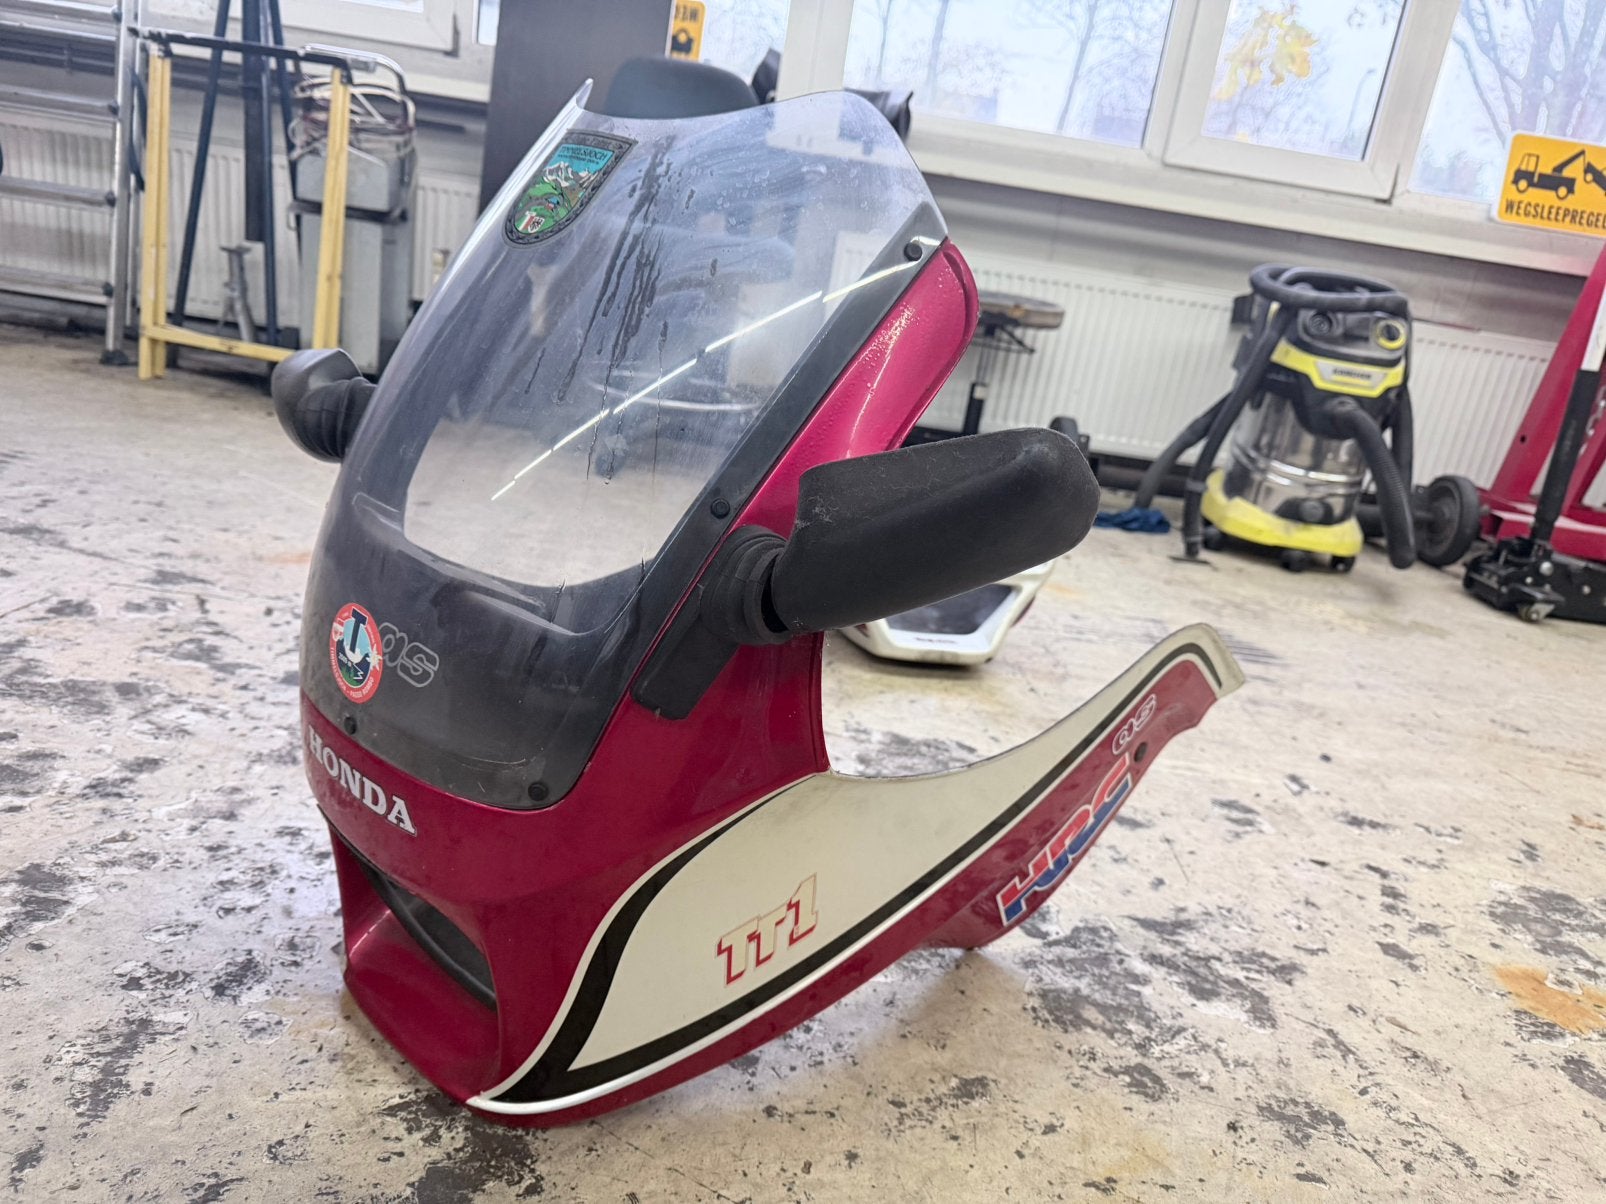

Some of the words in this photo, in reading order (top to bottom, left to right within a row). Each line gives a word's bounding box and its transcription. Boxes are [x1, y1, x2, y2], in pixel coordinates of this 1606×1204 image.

[308, 724, 417, 836] HONDA
[996, 752, 1132, 926] HRC
[716, 872, 818, 986] TT1
